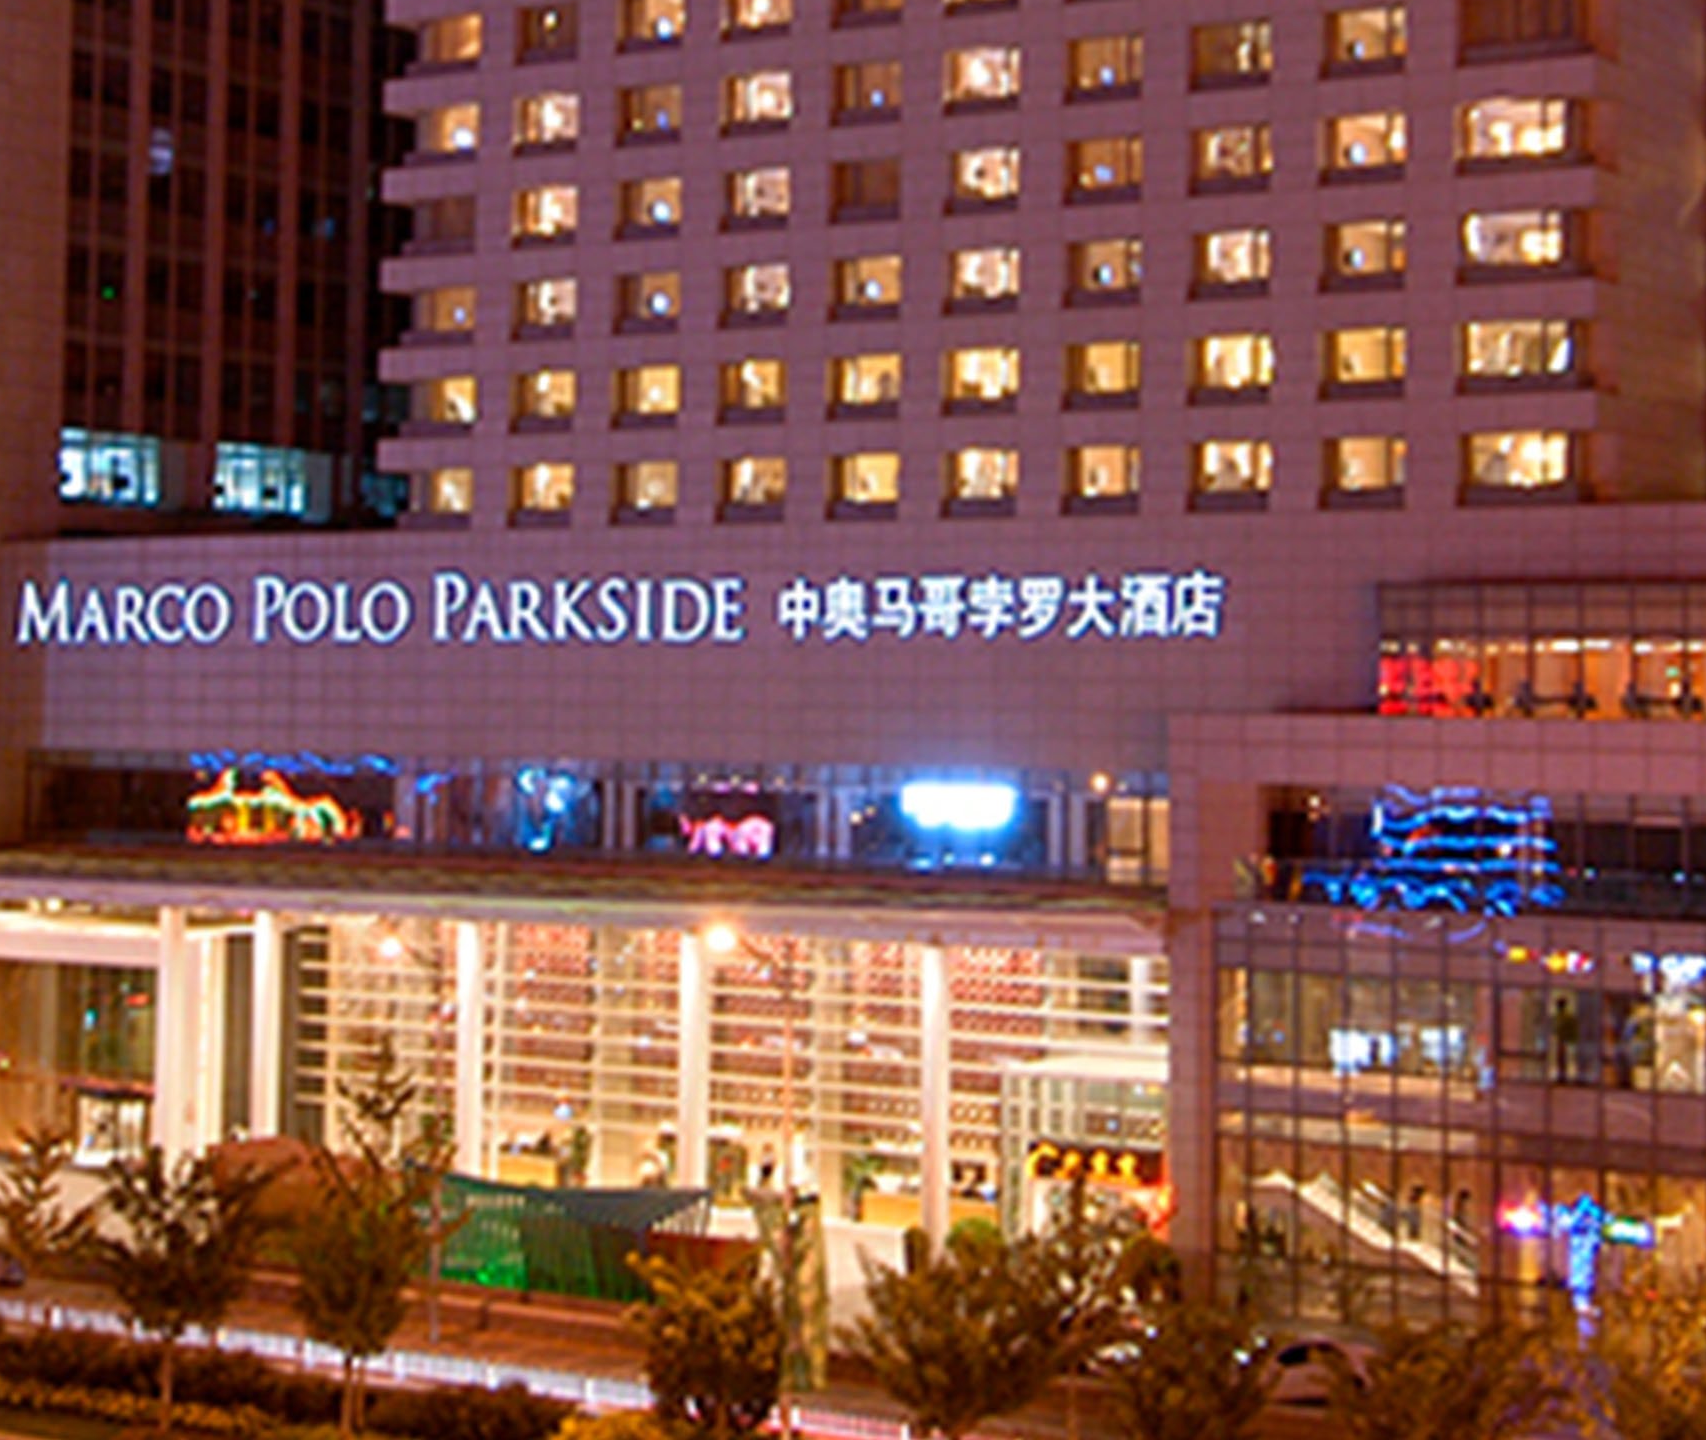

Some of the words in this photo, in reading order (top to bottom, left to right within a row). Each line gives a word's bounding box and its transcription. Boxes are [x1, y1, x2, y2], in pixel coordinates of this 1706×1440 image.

[16, 576, 231, 644] MARCO
[252, 572, 412, 644] POLO
[433, 570, 745, 644] PARKSIDE
